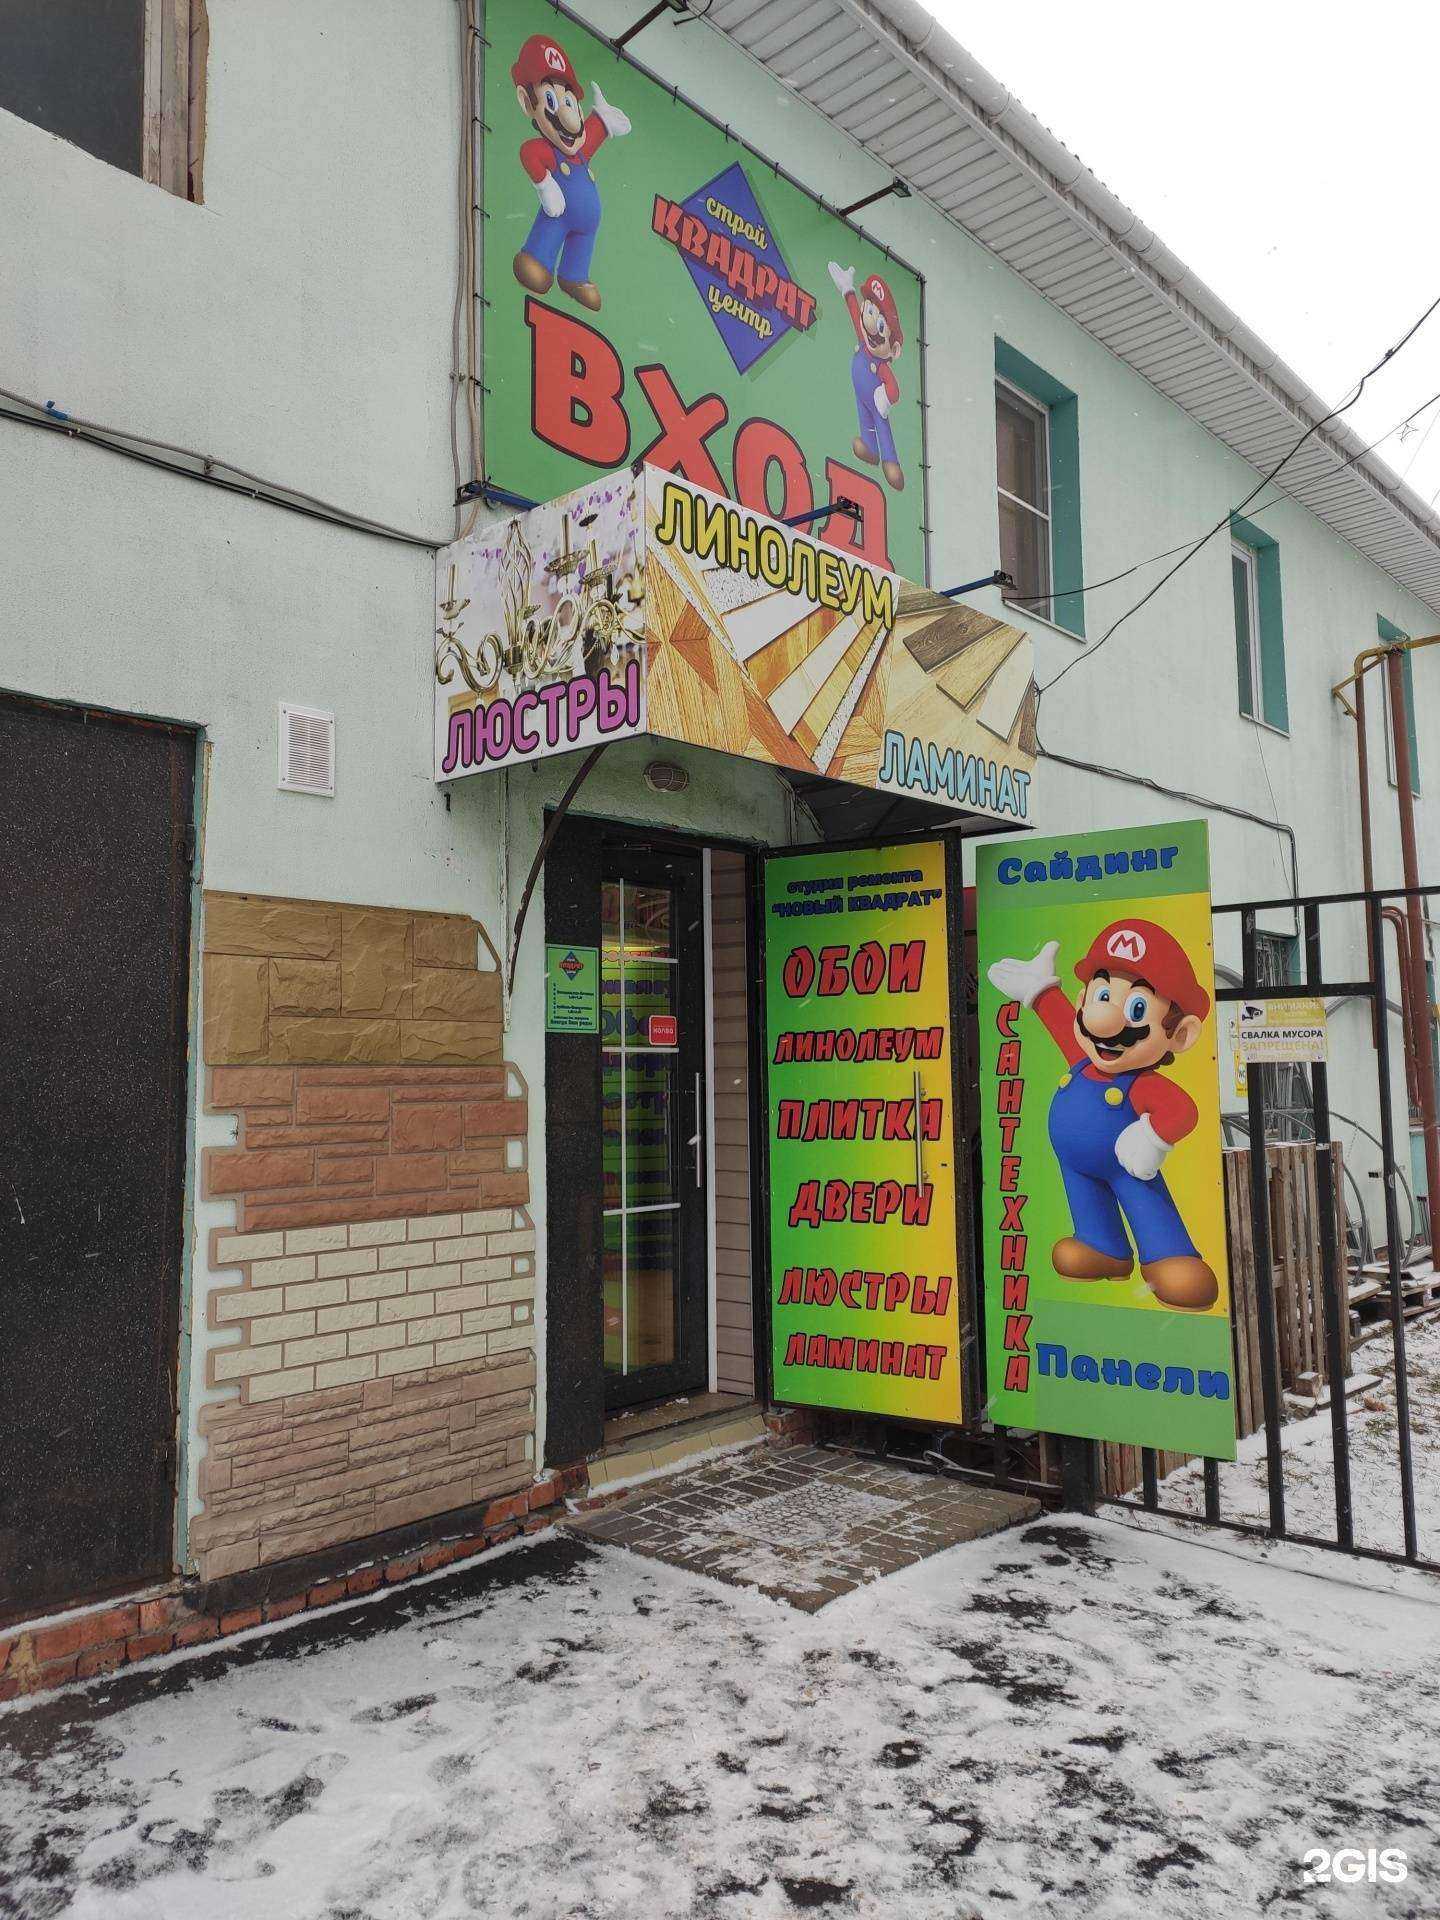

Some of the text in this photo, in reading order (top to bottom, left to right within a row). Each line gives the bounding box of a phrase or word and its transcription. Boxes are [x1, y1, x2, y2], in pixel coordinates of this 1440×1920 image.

[706, 197, 768, 250] строй
[652, 194, 816, 331] КВАДРАТ
[708, 284, 773, 339] центр
[525, 295, 894, 572] ВХОД
[656, 482, 893, 630] ЛИНОЛЕУМ
[441, 661, 640, 774] ЛЮСТРЫ
[879, 729, 1031, 818] ЛАМИНАТ
[787, 870, 923, 895] студия ремонта
[998, 847, 1178, 885] Сайдинг
[783, 940, 926, 998] ОБОИ
[1111, 934, 1141, 959] M
[773, 1027, 944, 1064] ЛИНОЛЕУМ
[1241, 1031, 1280, 1039] СВАЛКА
[1282, 1030, 1323, 1039] МУСОРА
[777, 1099, 943, 1142] ПЛИТКА
[788, 1179, 933, 1228] ДВЕРИ
[996, 1001, 1033, 1393] САНТЕХНИКА
[778, 1267, 952, 1315] ЛЮСТРЫ
[783, 1332, 947, 1380] ЛАМИНАТ
[1036, 1343, 1230, 1400] Панели
